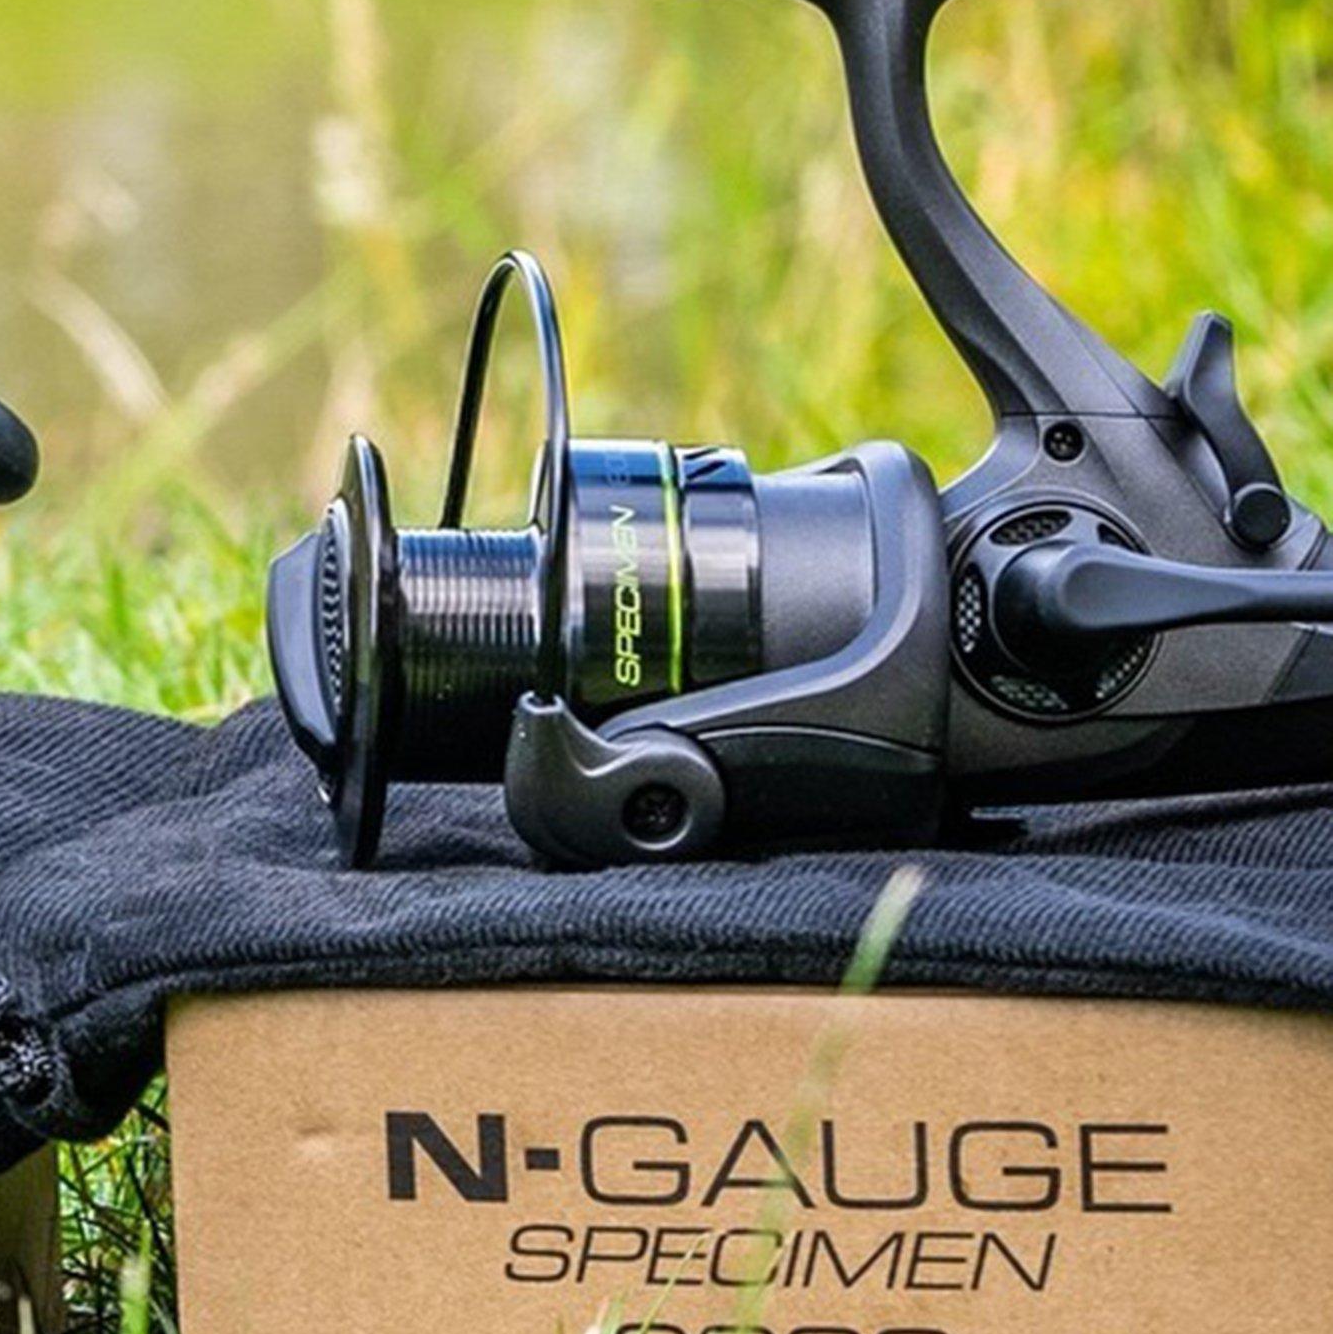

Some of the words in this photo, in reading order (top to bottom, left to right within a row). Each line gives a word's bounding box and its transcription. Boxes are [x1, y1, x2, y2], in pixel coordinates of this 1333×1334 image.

[610, 504, 642, 687] SPECIMEN
[385, 1111, 1172, 1213] N-GAUGE
[504, 1224, 1056, 1291] SPECIMEN
